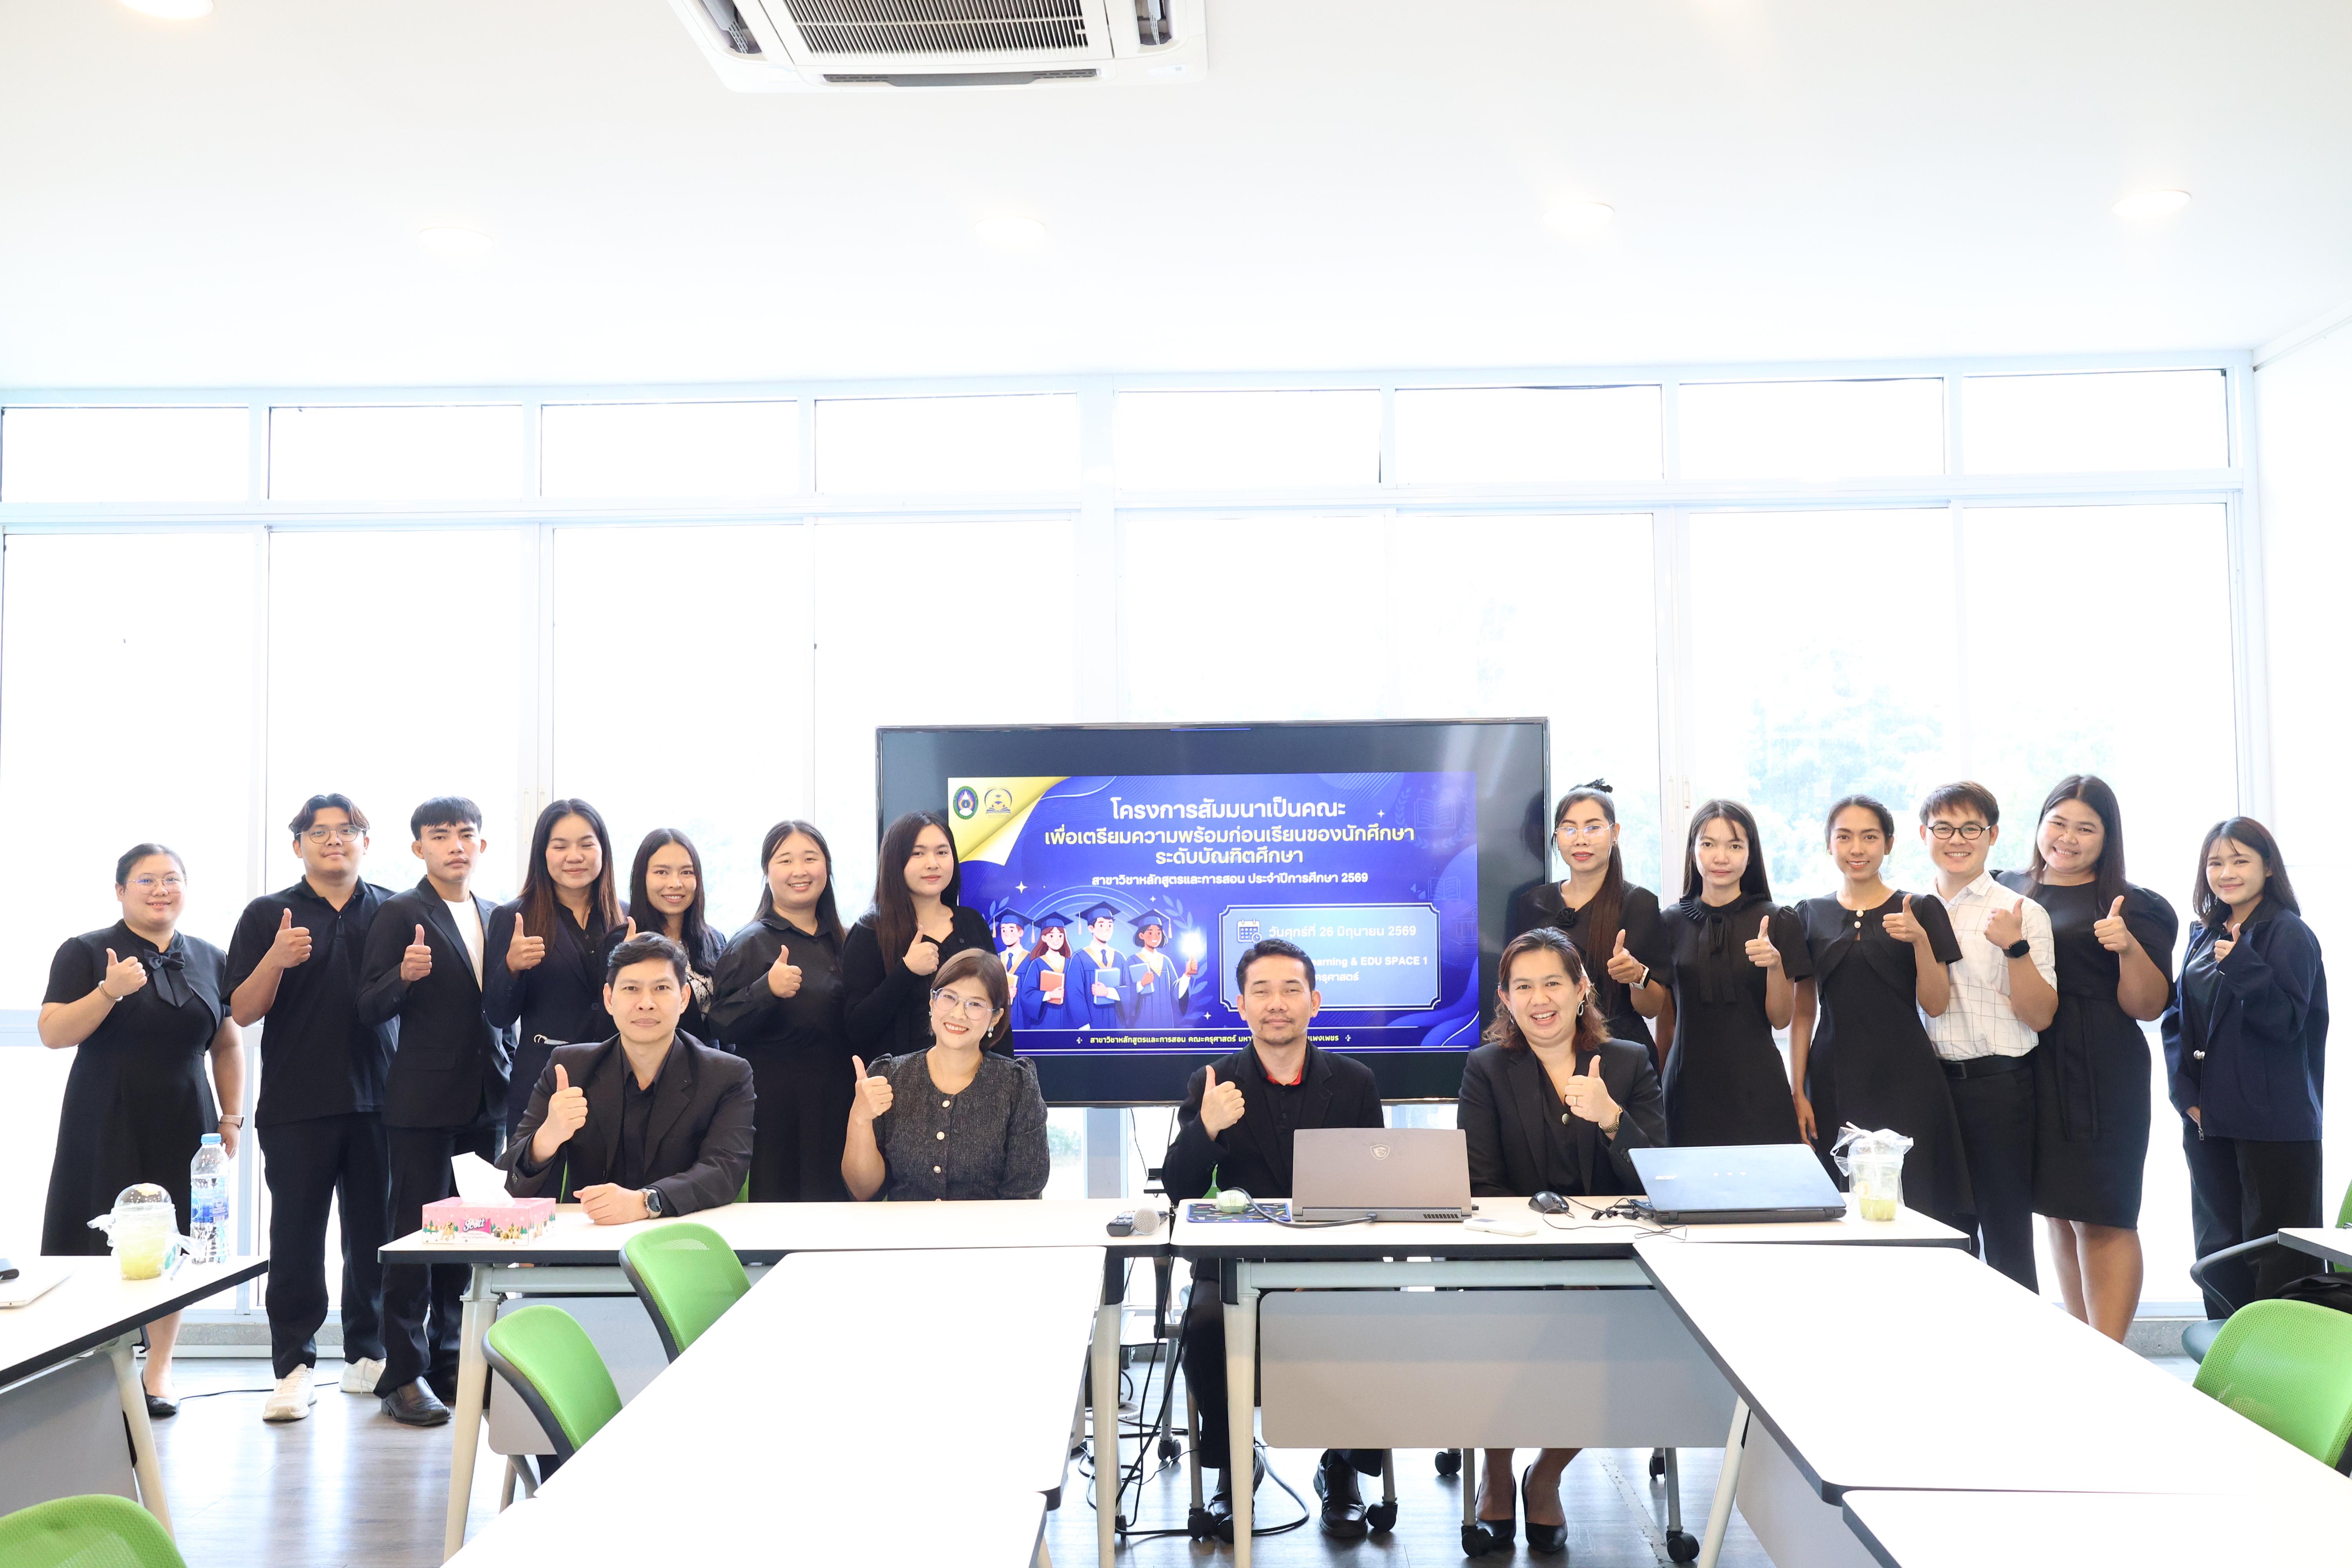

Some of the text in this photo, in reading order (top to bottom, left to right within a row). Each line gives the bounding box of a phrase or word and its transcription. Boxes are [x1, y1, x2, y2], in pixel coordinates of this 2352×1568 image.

[1110, 796, 1346, 819] โครงการสัมมนาเป็นคณะ
[1045, 823, 1414, 845] เพื่อเตรียมความพร้อมก่อนเรียนของนักศึกษา
[1156, 846, 1303, 864] ระดับบัณฑิตศึกษา
[1092, 871, 1368, 888] สาขาวิชาหลักสูตรและการสอน ประจำปีการศึกษา 2569
[1269, 923, 1417, 940] วันศุกร์ที่ 26 มิถุนายน 2569
[1311, 956, 1427, 968] earning & EDU SPACE 1
[1315, 971, 1359, 984] ครุศาสตร์
[1090, 1035, 1186, 1045] สาขาวิชาหลักสูตรและการสอน
[1188, 1034, 1237, 1045] คณะครุศาสตร์
